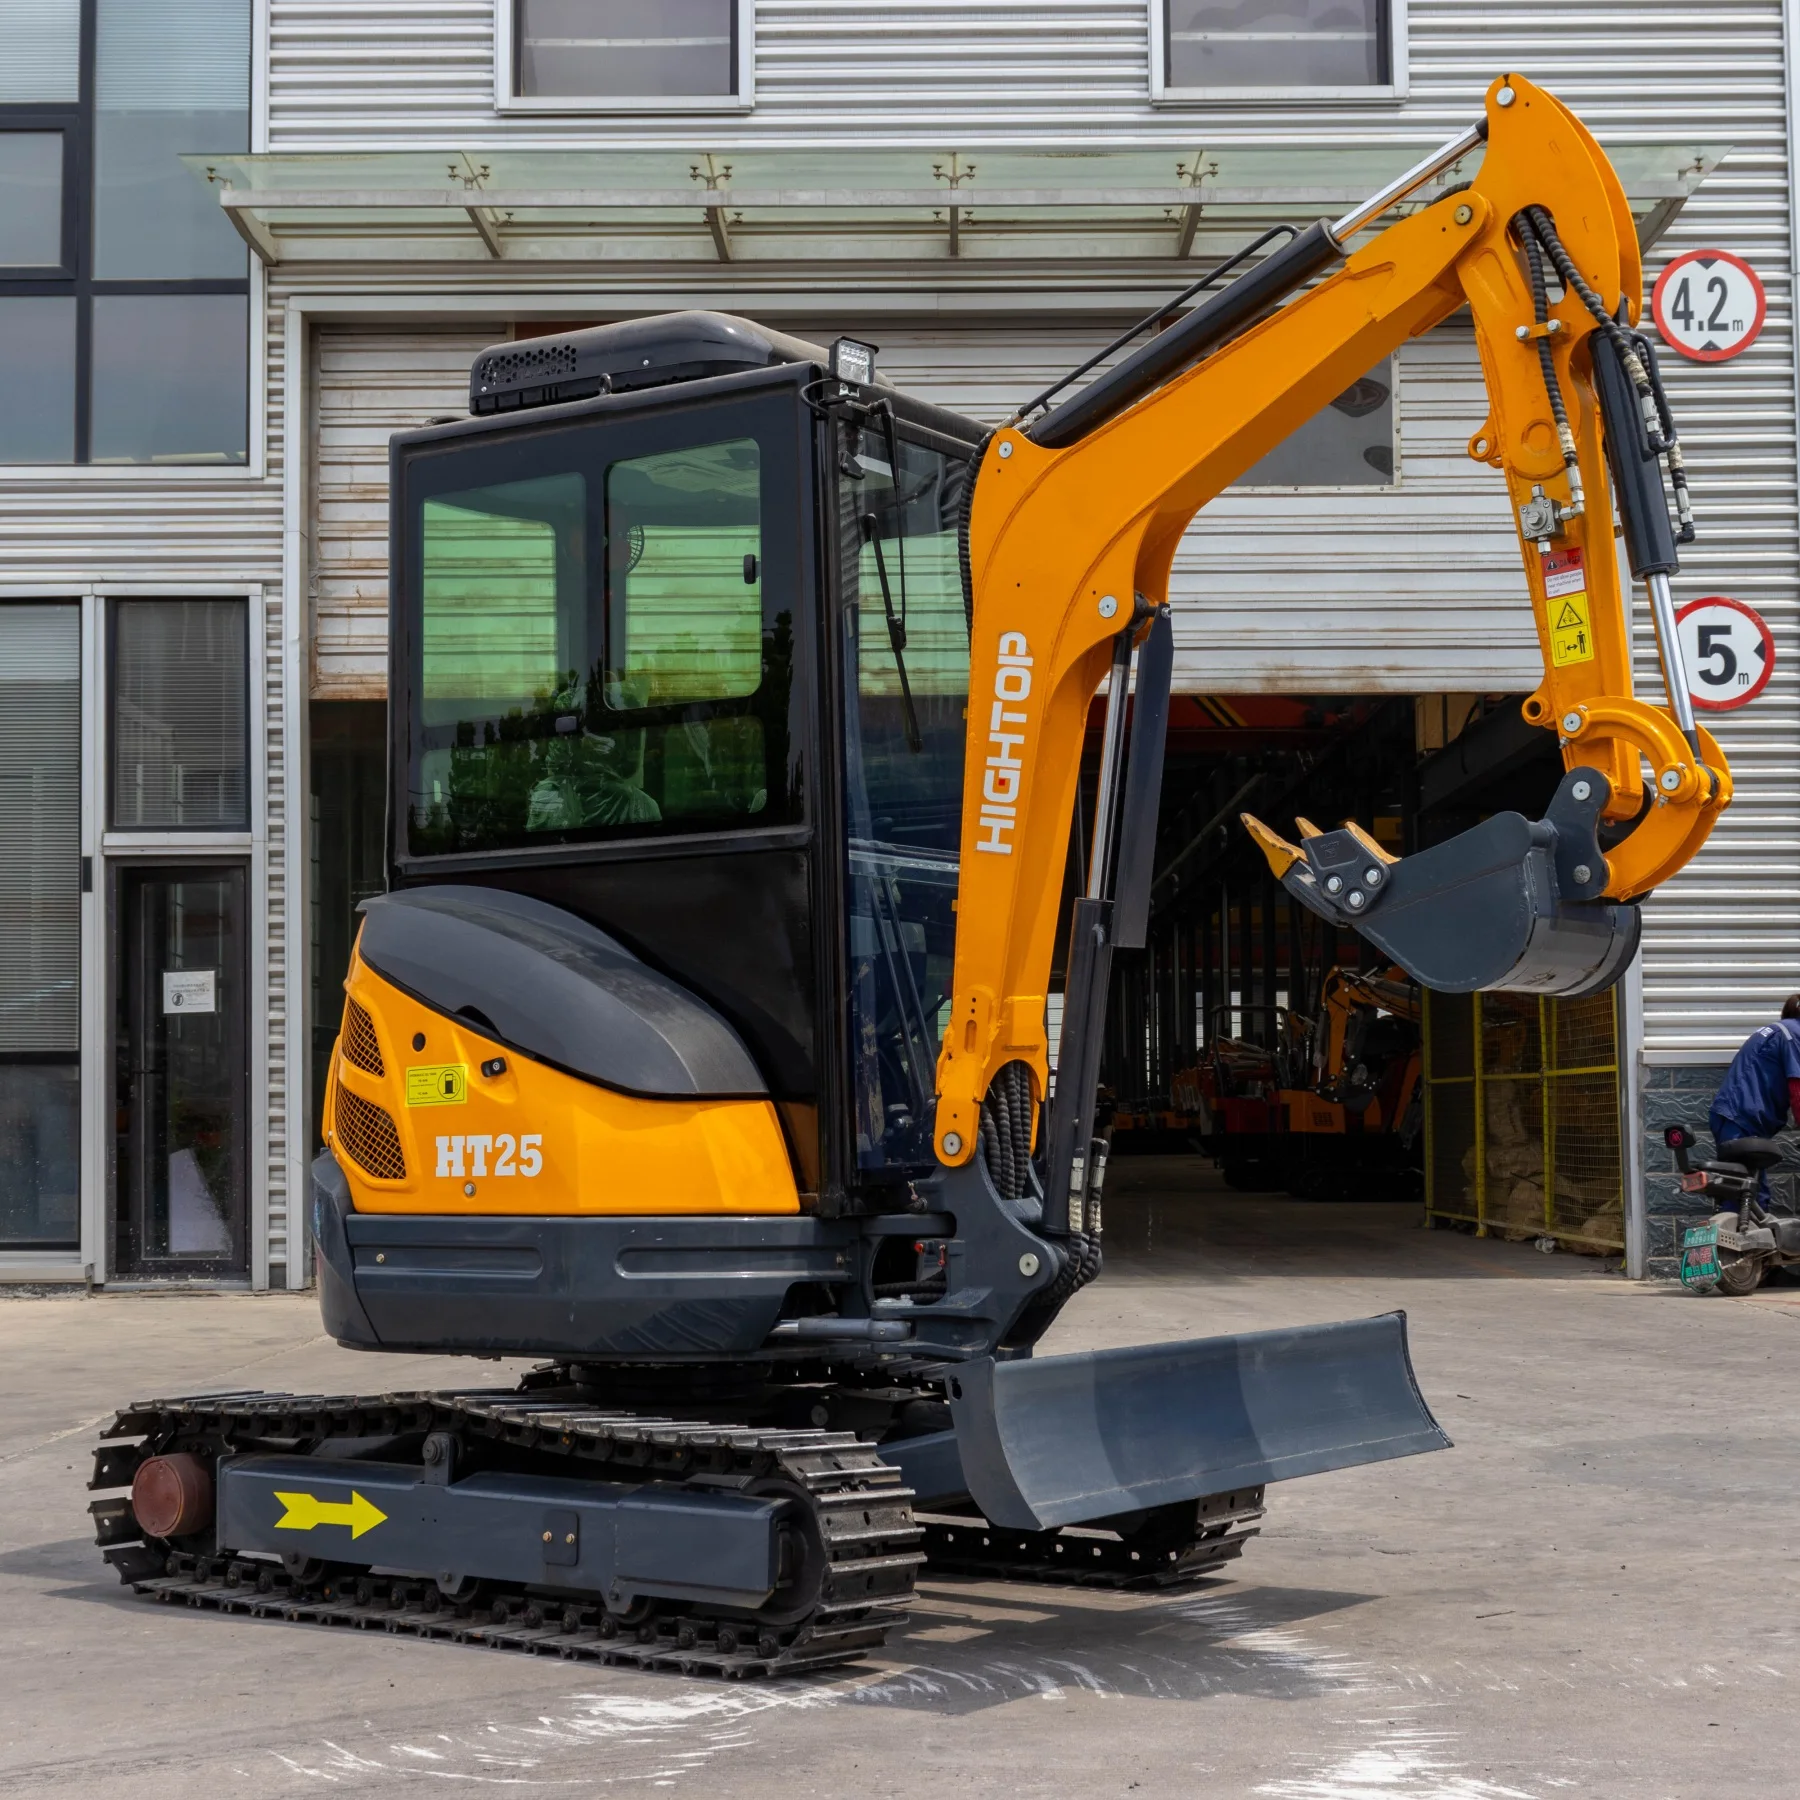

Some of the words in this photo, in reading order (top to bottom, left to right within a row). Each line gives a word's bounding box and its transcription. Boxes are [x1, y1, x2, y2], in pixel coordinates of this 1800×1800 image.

[1559, 555, 1580, 567] DANGER
[976, 631, 1034, 854] HIGHTOP
[435, 1133, 543, 1177] HT25
